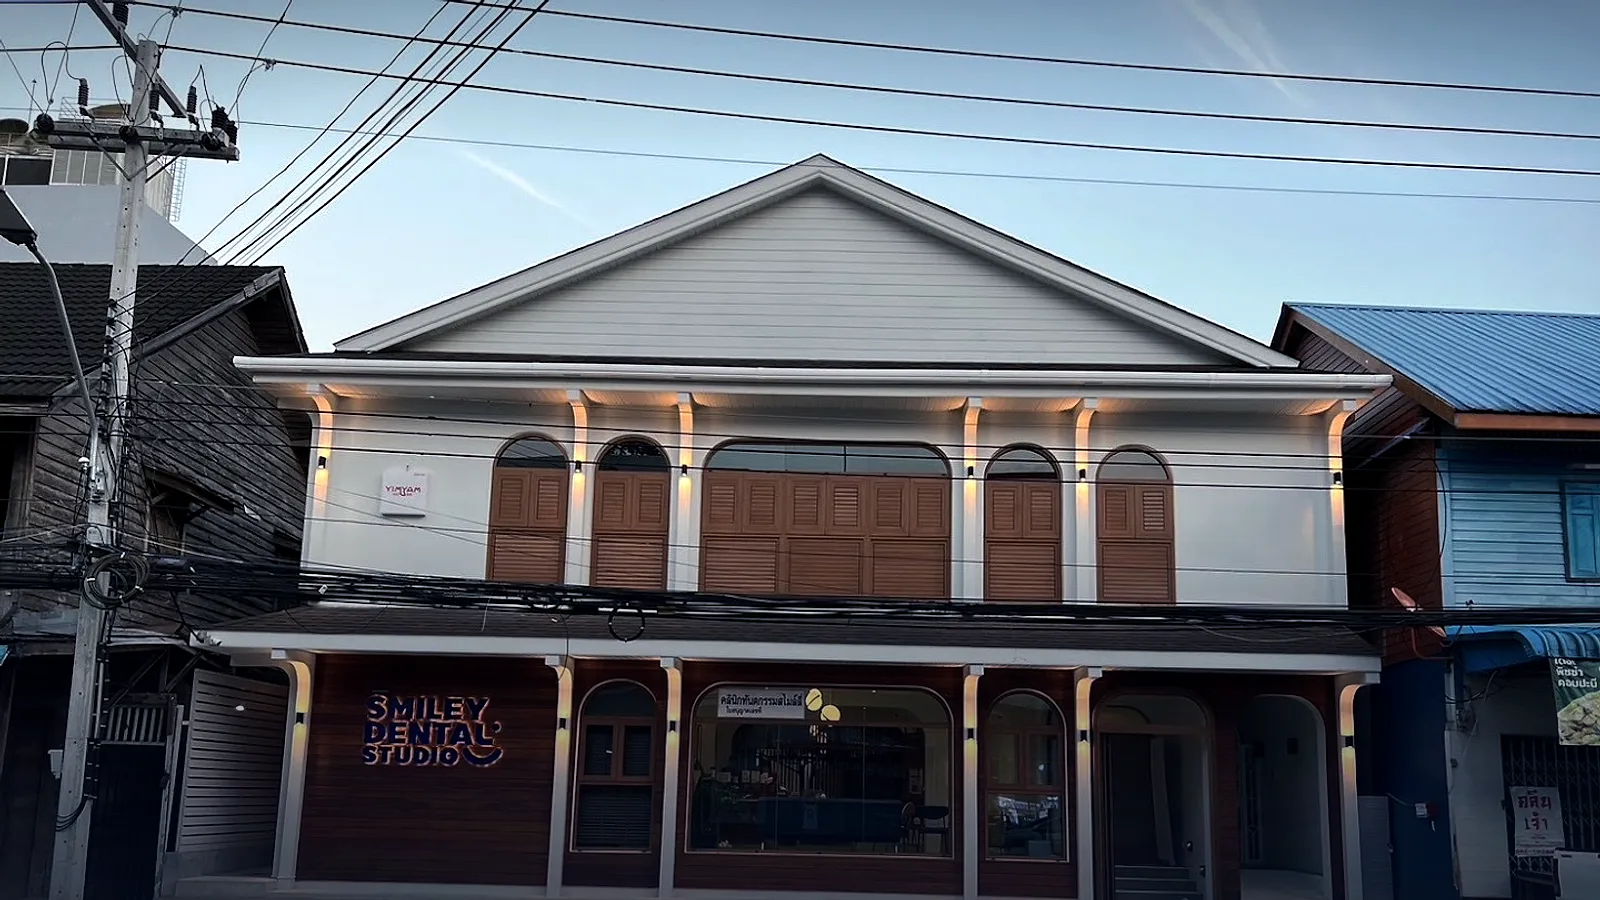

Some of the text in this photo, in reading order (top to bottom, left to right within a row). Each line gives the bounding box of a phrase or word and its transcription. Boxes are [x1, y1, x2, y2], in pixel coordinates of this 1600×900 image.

[385, 485, 421, 495] YIMYAM
[365, 694, 490, 722] SMILEY
[363, 721, 495, 746] DENTAL
[362, 743, 460, 766] STUDIO
